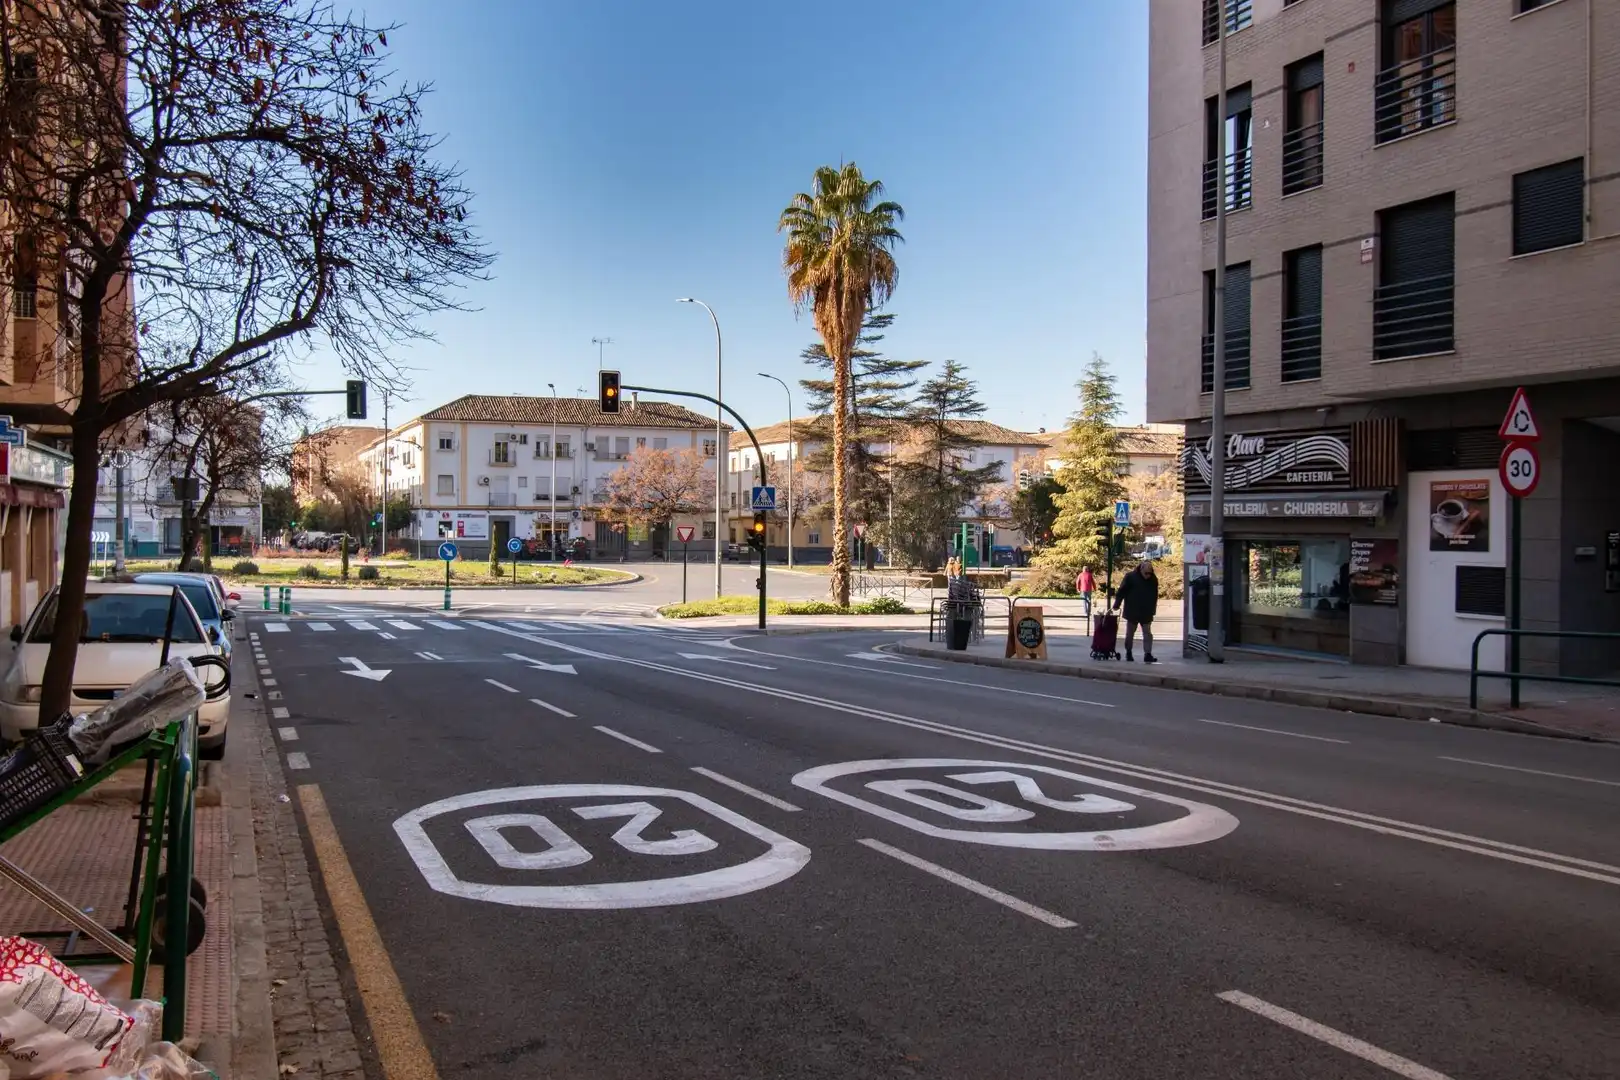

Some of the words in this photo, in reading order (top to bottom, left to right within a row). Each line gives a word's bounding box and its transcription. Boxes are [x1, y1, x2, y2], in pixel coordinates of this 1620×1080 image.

[1228, 433, 1265, 458] Clave
[1286, 471, 1333, 483] CAFETERIA
[1510, 459, 1532, 477] 30
[1222, 502, 1269, 517] STELERIA
[1283, 501, 1349, 516] CHURRERIA
[864, 770, 1137, 822] 20
[463, 801, 719, 870] 20
